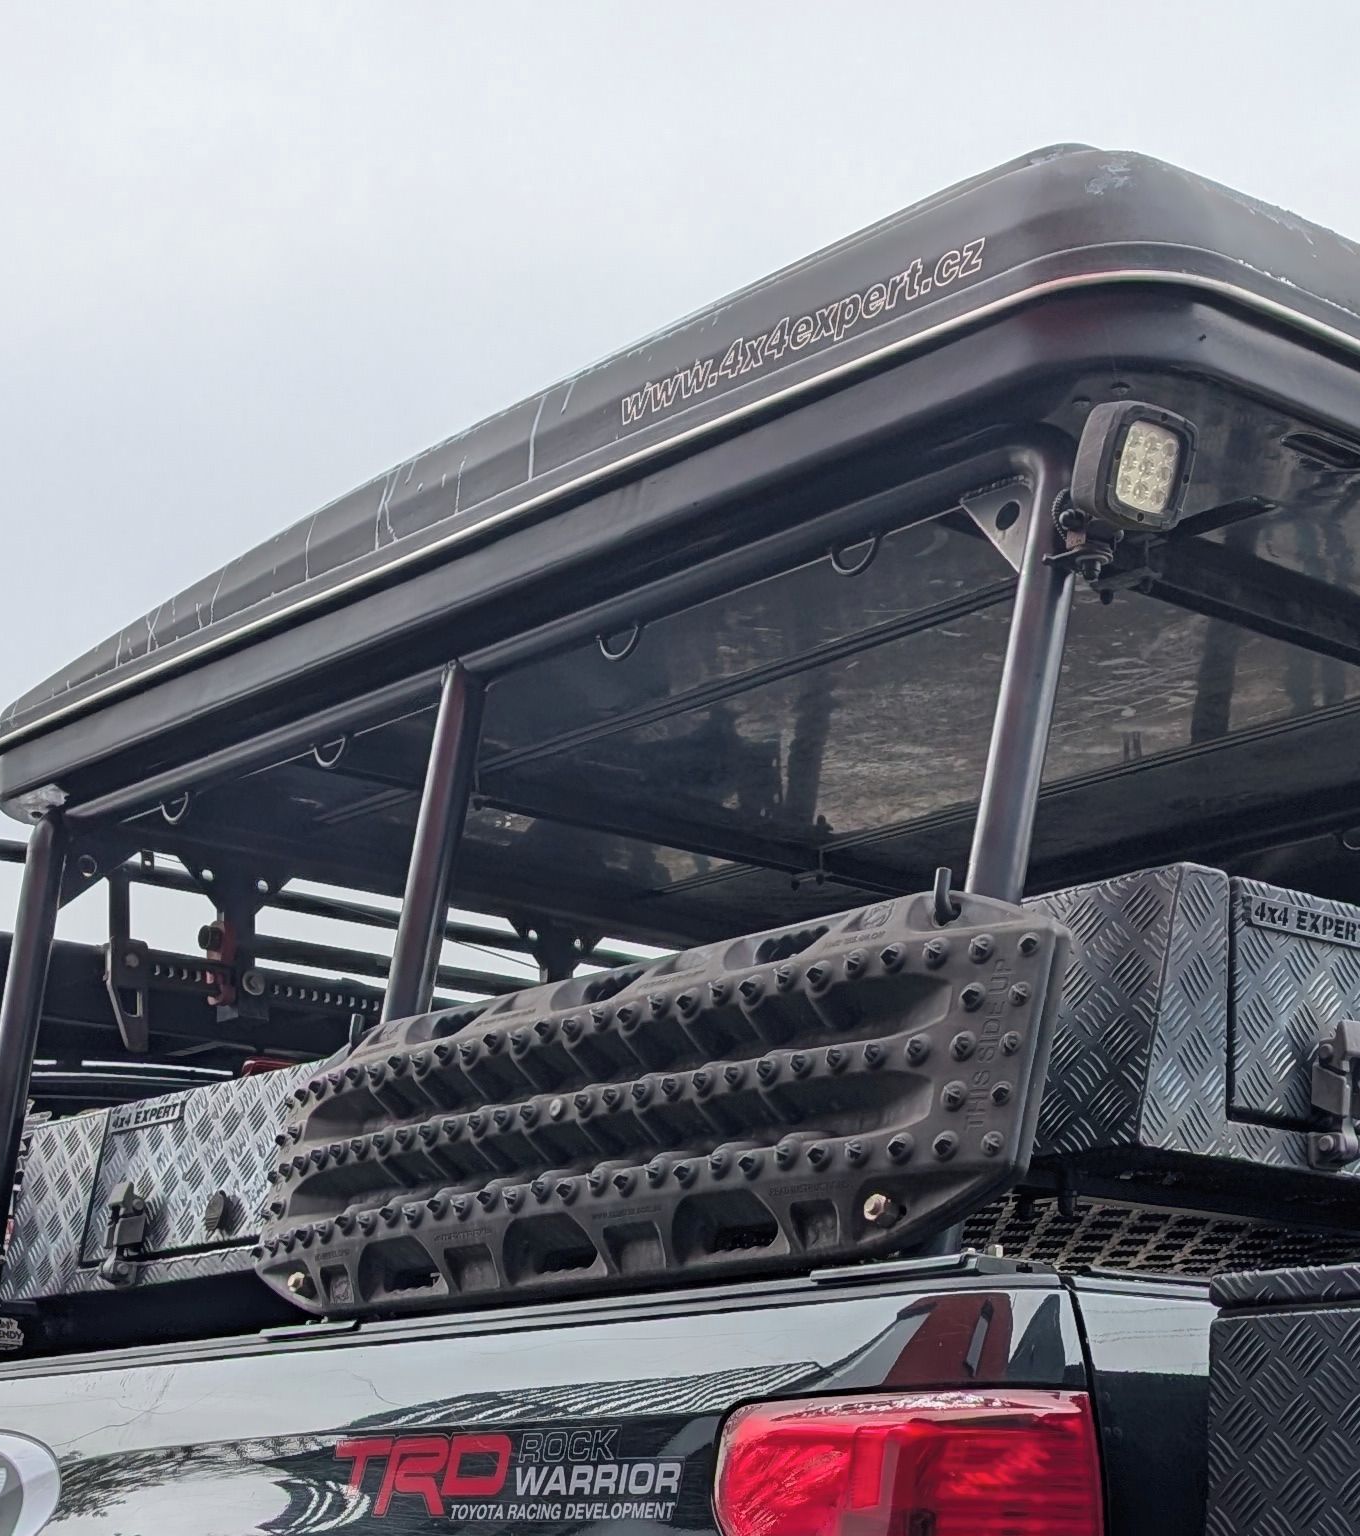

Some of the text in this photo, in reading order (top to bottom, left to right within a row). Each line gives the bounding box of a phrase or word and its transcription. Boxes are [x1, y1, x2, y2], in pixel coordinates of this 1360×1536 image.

[622, 237, 986, 427] www.4x4expert.cz
[1254, 902, 1289, 926] 4x4
[966, 958, 1017, 1131] THIS SIDE UP
[112, 1102, 180, 1129] 4x4 EXPERT
[334, 1428, 618, 1518] TRD ROCK
[515, 1462, 682, 1496] WARRIOR
[450, 1501, 676, 1521] TOYOTA RACING DEVELOPMENT
